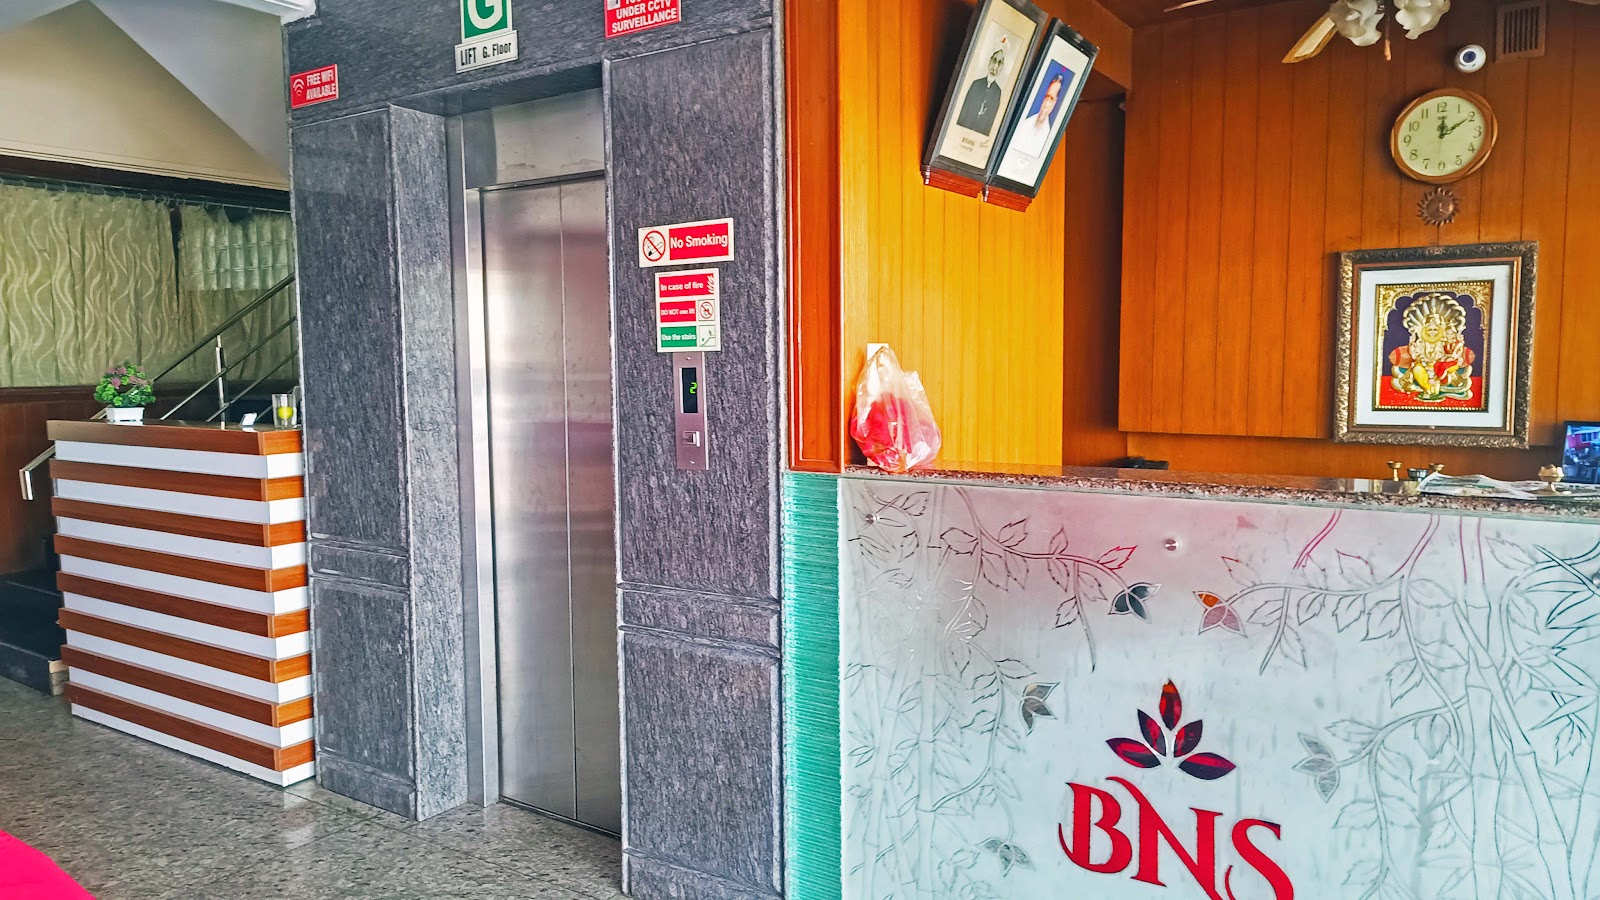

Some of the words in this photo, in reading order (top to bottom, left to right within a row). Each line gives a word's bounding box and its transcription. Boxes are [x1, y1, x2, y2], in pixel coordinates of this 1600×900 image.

[467, 0, 503, 30] G
[616, 3, 646, 19] UNDER
[647, 0, 671, 12] CCTV
[611, 8, 677, 33] SURVEILLANCE
[460, 47, 476, 66] LIFT
[483, 46, 490, 58] G.
[492, 42, 511, 57] Floor
[306, 72, 321, 87] FREE
[306, 83, 336, 100] AVAILABLE
[1437, 102, 1447, 113] 12
[1468, 111, 1475, 122] 2
[1409, 121, 1420, 132] 10
[1403, 135, 1411, 146] 9
[1468, 143, 1476, 153] 4
[1409, 149, 1417, 160] 8
[1455, 155, 1462, 165] 5
[1422, 158, 1430, 169] 7
[670, 236, 684, 249] No
[685, 233, 728, 248] Smoking
[660, 283, 668, 291] In
[668, 283, 683, 291] case
[684, 281, 691, 290] of
[692, 281, 704, 289] fire
[661, 333, 672, 341] Use
[672, 333, 681, 341] the
[681, 332, 697, 340] stairs
[689, 382, 698, 394] 2
[1058, 776, 1295, 900] BNS
